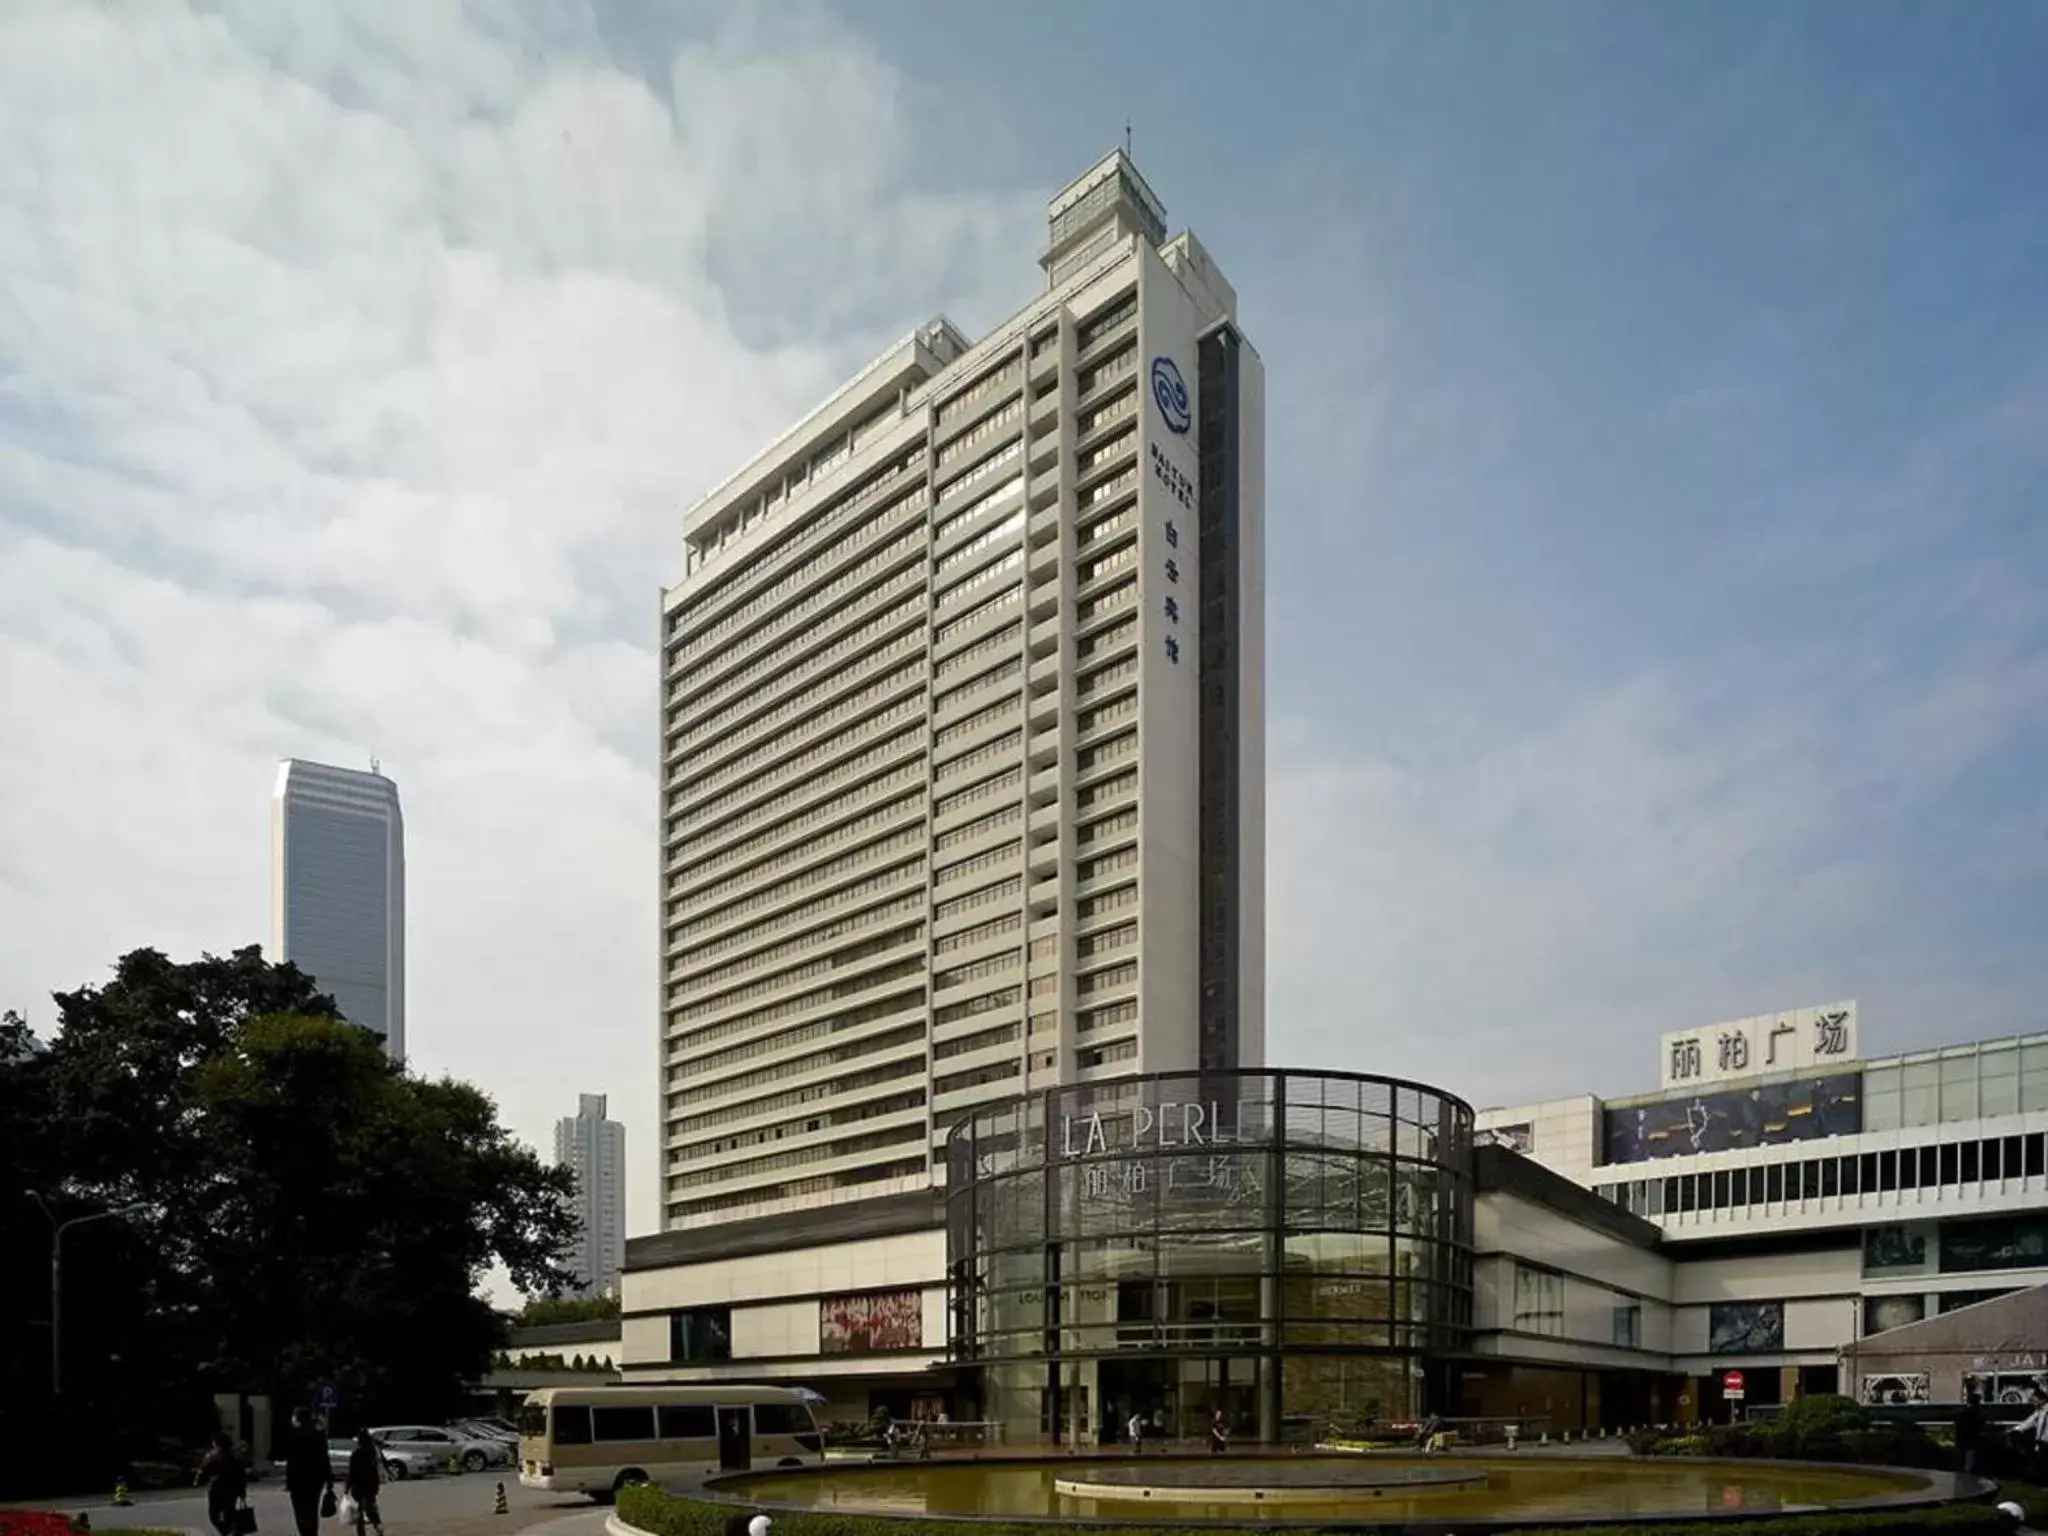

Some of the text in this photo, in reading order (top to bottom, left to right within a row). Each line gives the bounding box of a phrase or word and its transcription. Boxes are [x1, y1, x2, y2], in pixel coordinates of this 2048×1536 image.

[1671, 1010, 1848, 1080] 丽柏广场
[1065, 1100, 1257, 1157] LA PERLE
